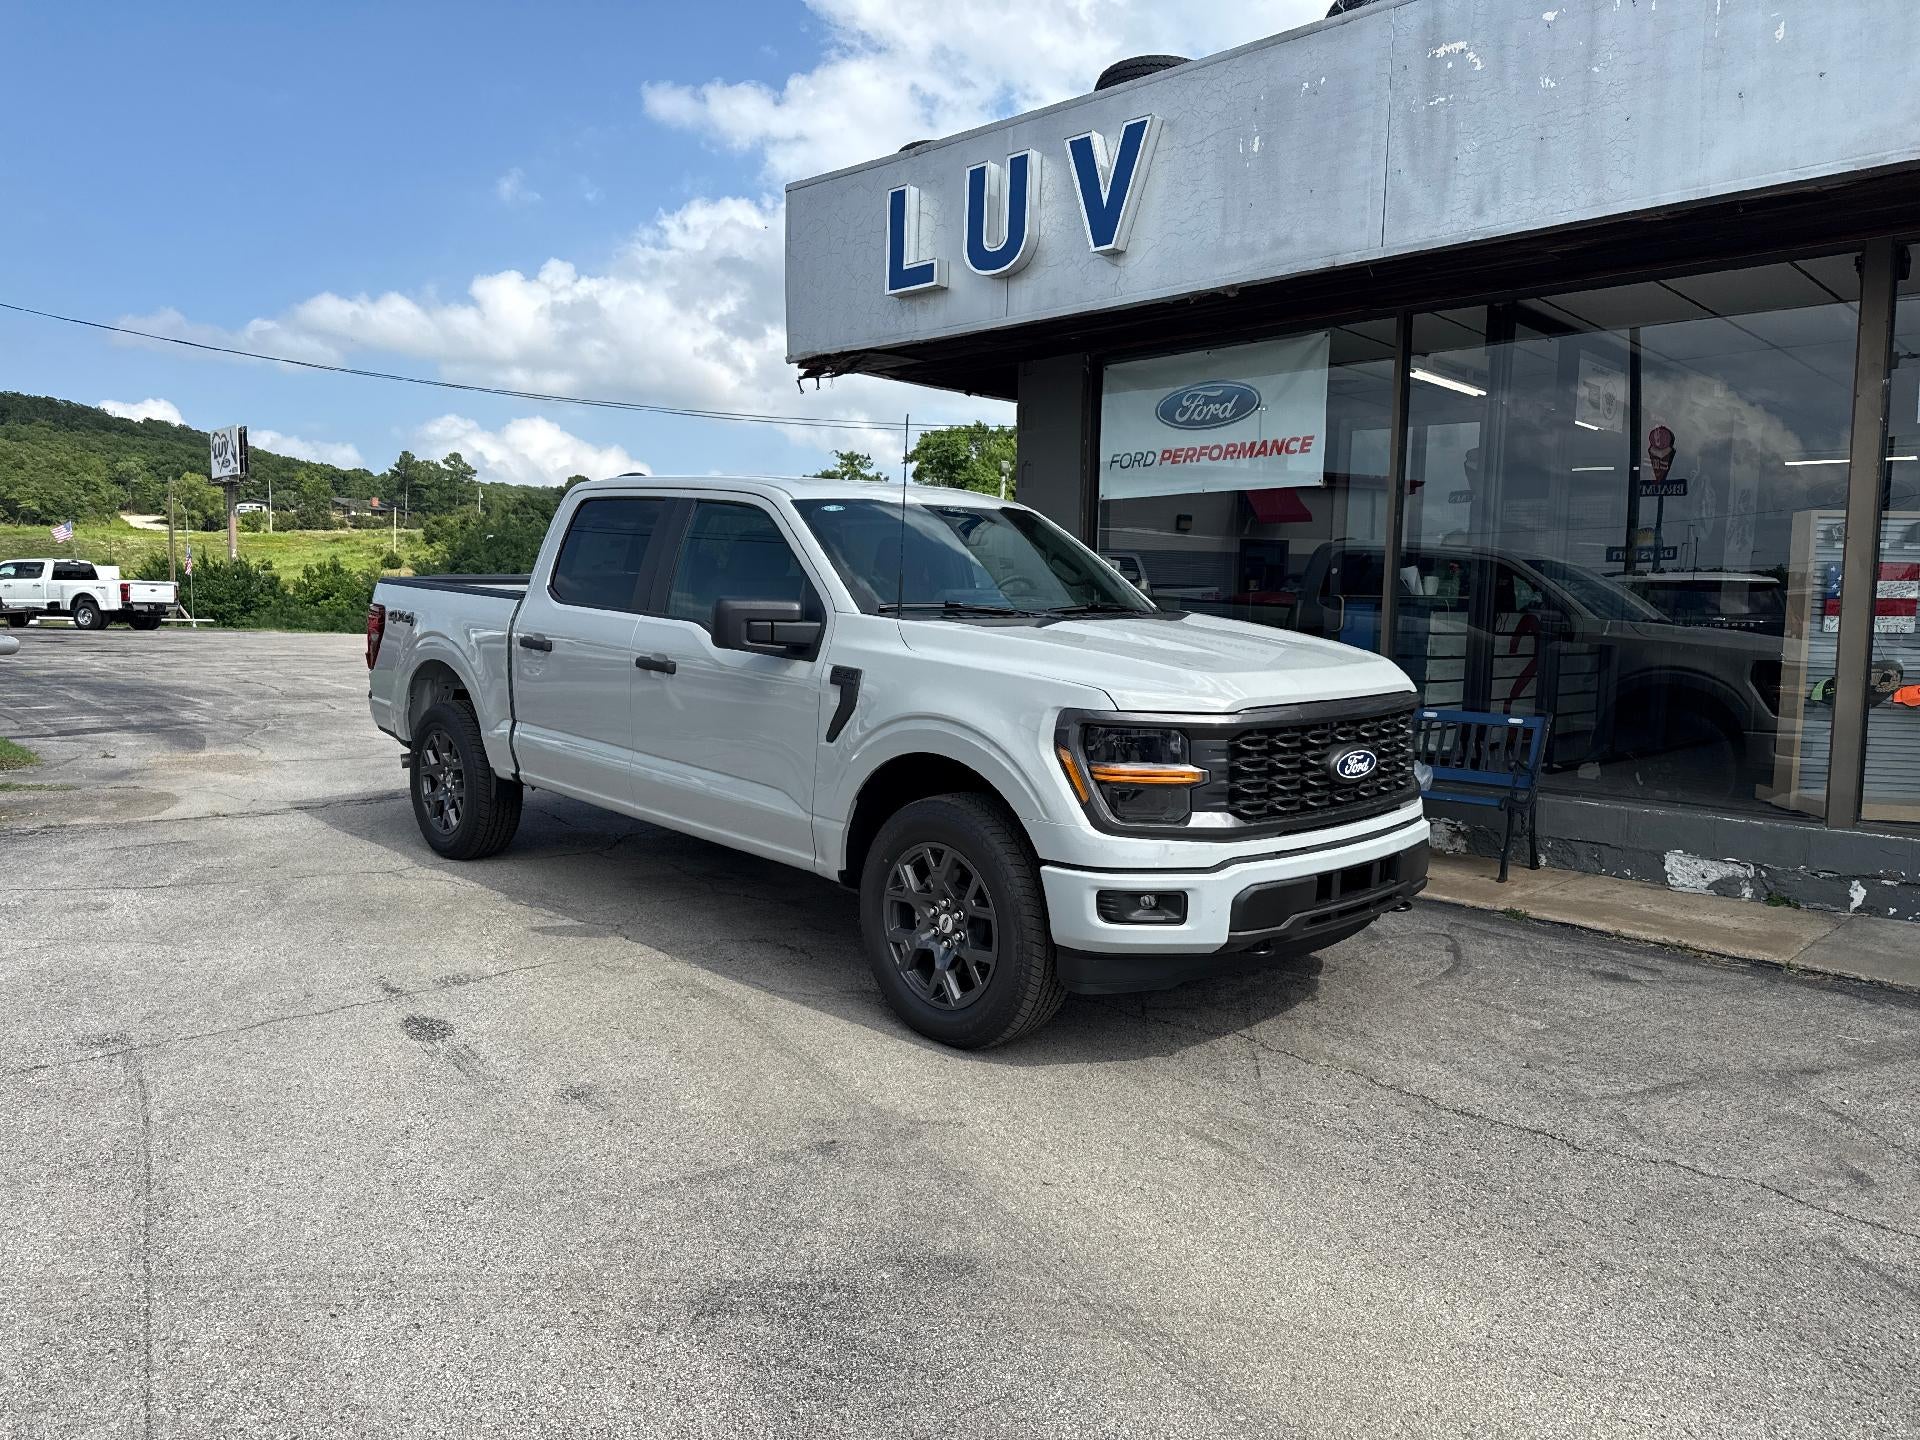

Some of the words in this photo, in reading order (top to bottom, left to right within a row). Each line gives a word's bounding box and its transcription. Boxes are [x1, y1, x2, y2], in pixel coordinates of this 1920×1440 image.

[884, 113, 1165, 298] LUV
[1175, 390, 1237, 423] Ford
[212, 439, 230, 460] LUV
[1109, 450, 1157, 471] FORD
[1158, 435, 1315, 467] PERFORMANCE
[1344, 754, 1370, 775] Ford
